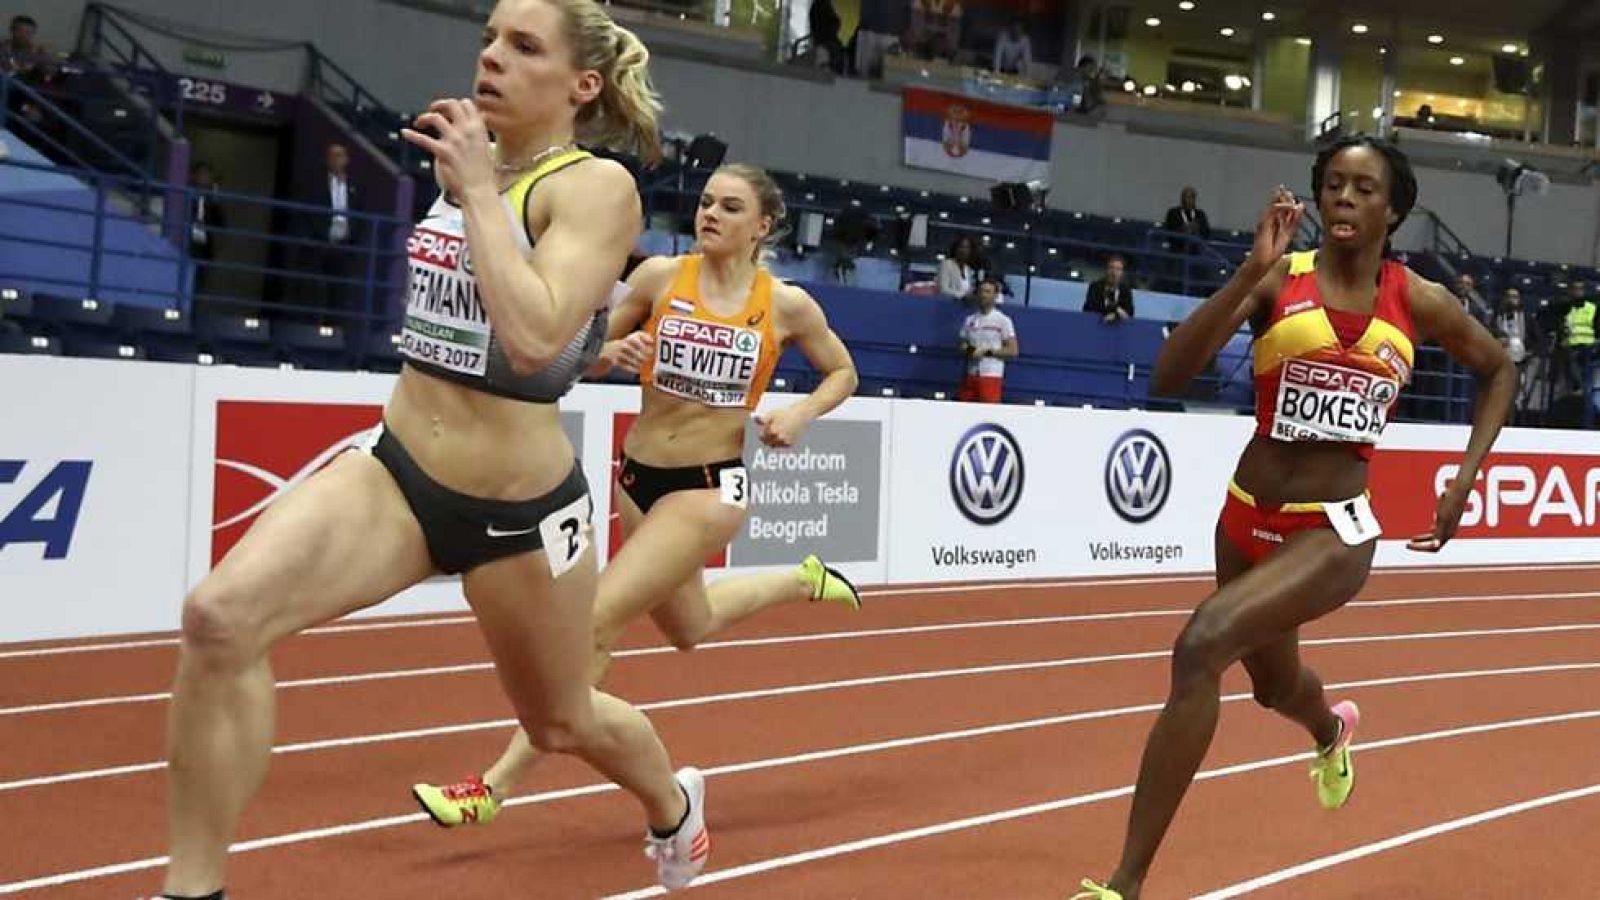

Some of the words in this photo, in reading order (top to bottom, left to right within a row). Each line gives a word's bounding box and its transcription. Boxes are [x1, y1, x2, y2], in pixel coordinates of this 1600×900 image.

[179, 78, 227, 104] 225
[406, 231, 460, 267] SPAR
[408, 265, 487, 325] FFMANN
[662, 319, 732, 346] SPAR
[444, 347, 481, 369] 2017
[660, 340, 686, 369] DE
[691, 347, 755, 380] WITTE
[1287, 363, 1370, 399] SPAR
[1282, 387, 1385, 433] BOKESA
[752, 448, 846, 471] Aerodrom
[732, 474, 745, 502] 3
[750, 480, 810, 505] Nikola
[814, 481, 860, 505] Tesla
[749, 514, 828, 544] Beograd
[1344, 502, 1364, 535] 1
[559, 517, 580, 561] 2
[1089, 541, 1183, 563] Volkswagen
[931, 545, 1036, 568] Volkswagen
